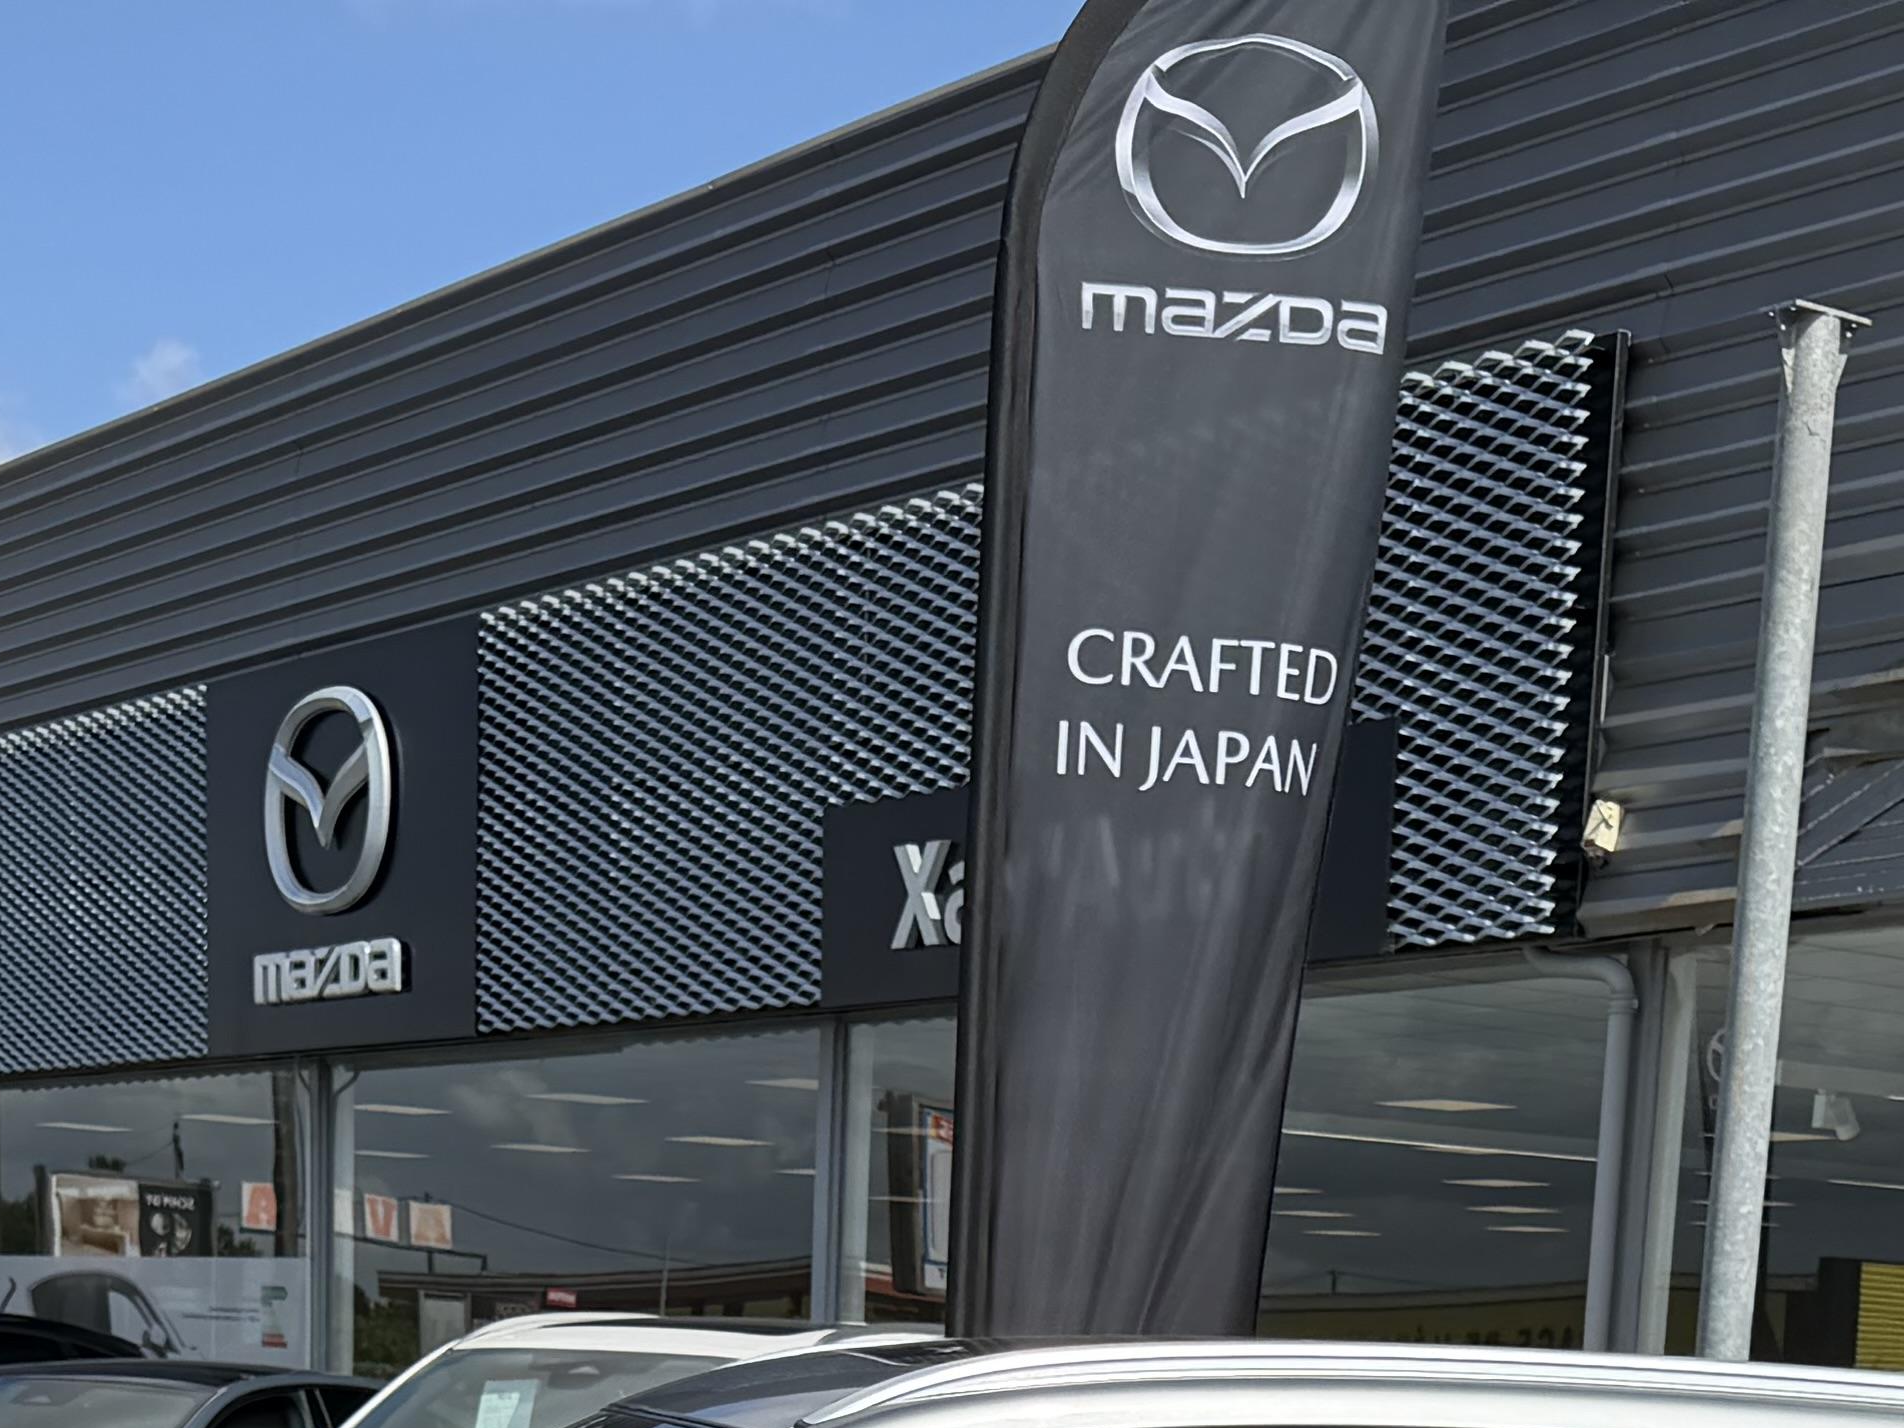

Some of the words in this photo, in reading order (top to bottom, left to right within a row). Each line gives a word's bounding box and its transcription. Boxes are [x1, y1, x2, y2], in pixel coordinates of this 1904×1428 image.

[1067, 628, 1337, 705] CRAFTED
[1056, 720, 1123, 777] IN
[1139, 725, 1317, 796] JAPAN
